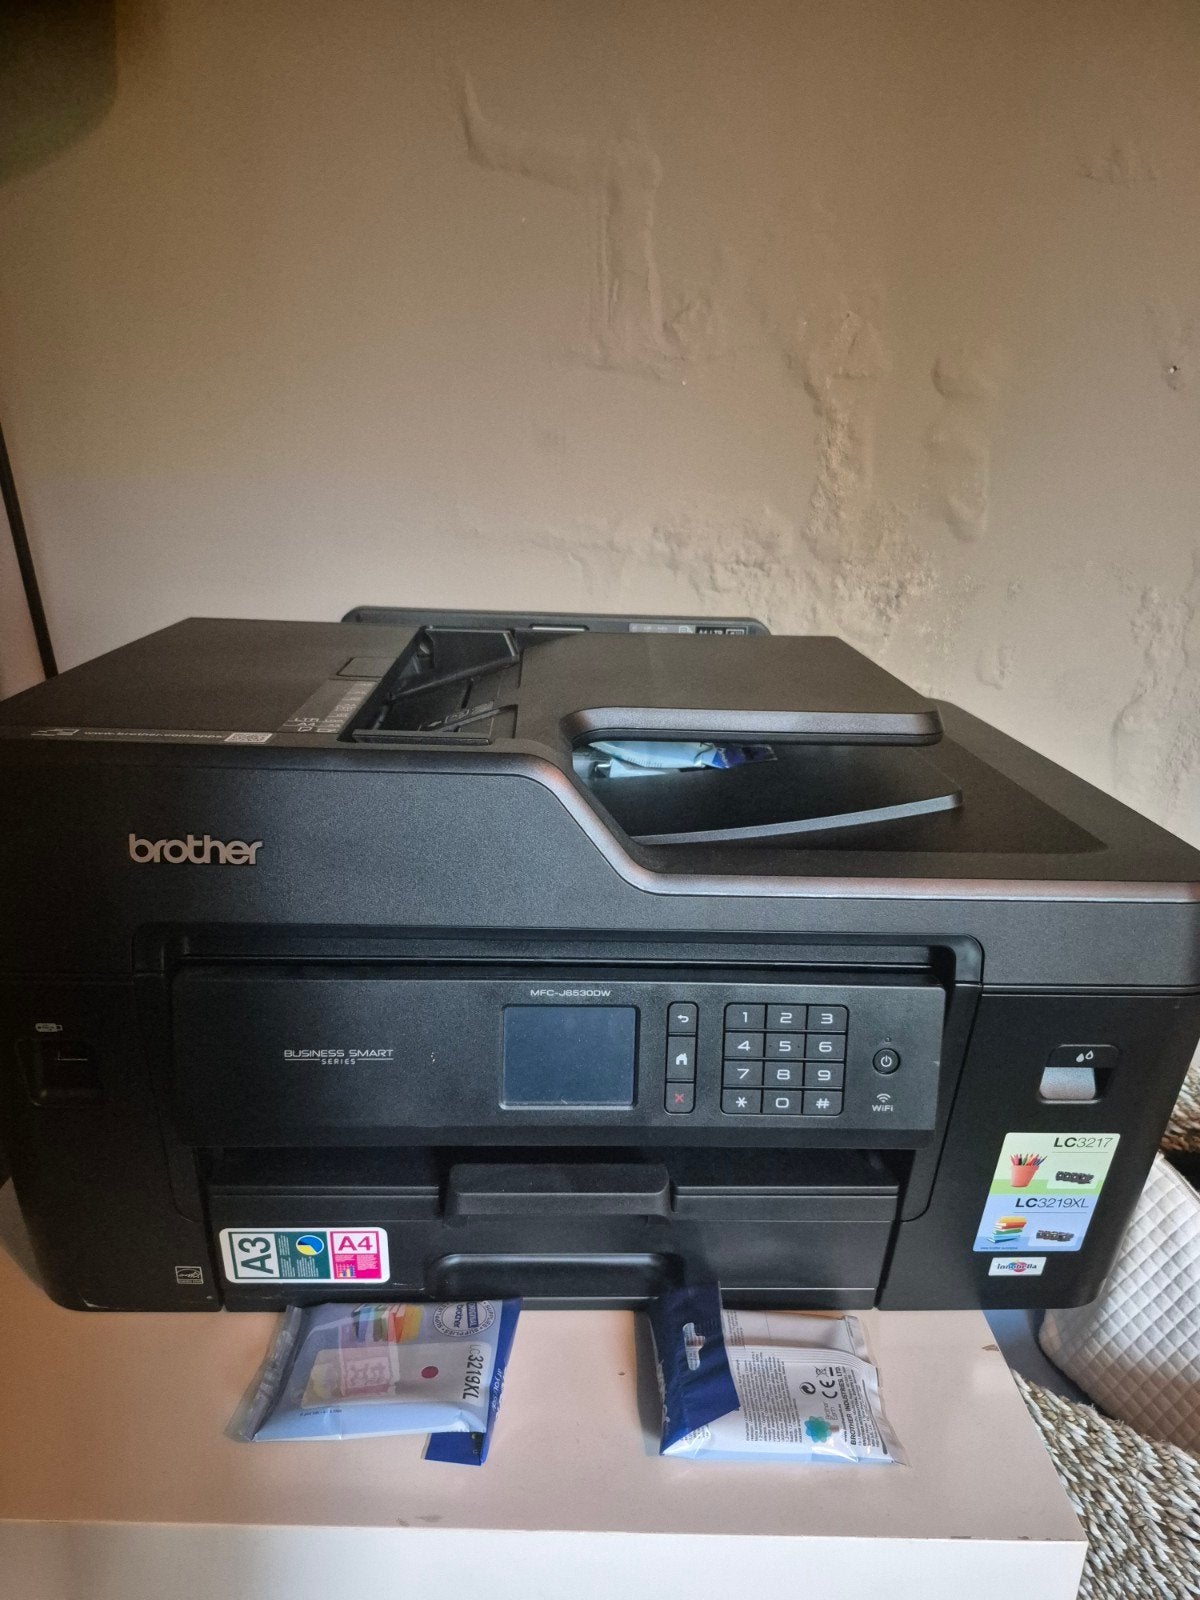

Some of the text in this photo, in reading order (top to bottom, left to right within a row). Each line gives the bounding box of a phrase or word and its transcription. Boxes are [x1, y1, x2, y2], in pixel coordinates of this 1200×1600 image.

[129, 833, 262, 864] brother
[742, 1011, 833, 1024] 1 2 3
[737, 1040, 832, 1052] 4 5 6
[284, 1049, 394, 1058] BUSINESS SMART
[737, 1068, 832, 1081] 7 8 9
[1054, 1137, 1113, 1148] LC3217
[1015, 1197, 1089, 1209] LC3219XL
[338, 1235, 373, 1251] A4
[237, 1236, 274, 1275] A3
[453, 1304, 464, 1328] brother
[462, 1344, 485, 1400] LC3219XL
[846, 1413, 857, 1446] BROTHER
